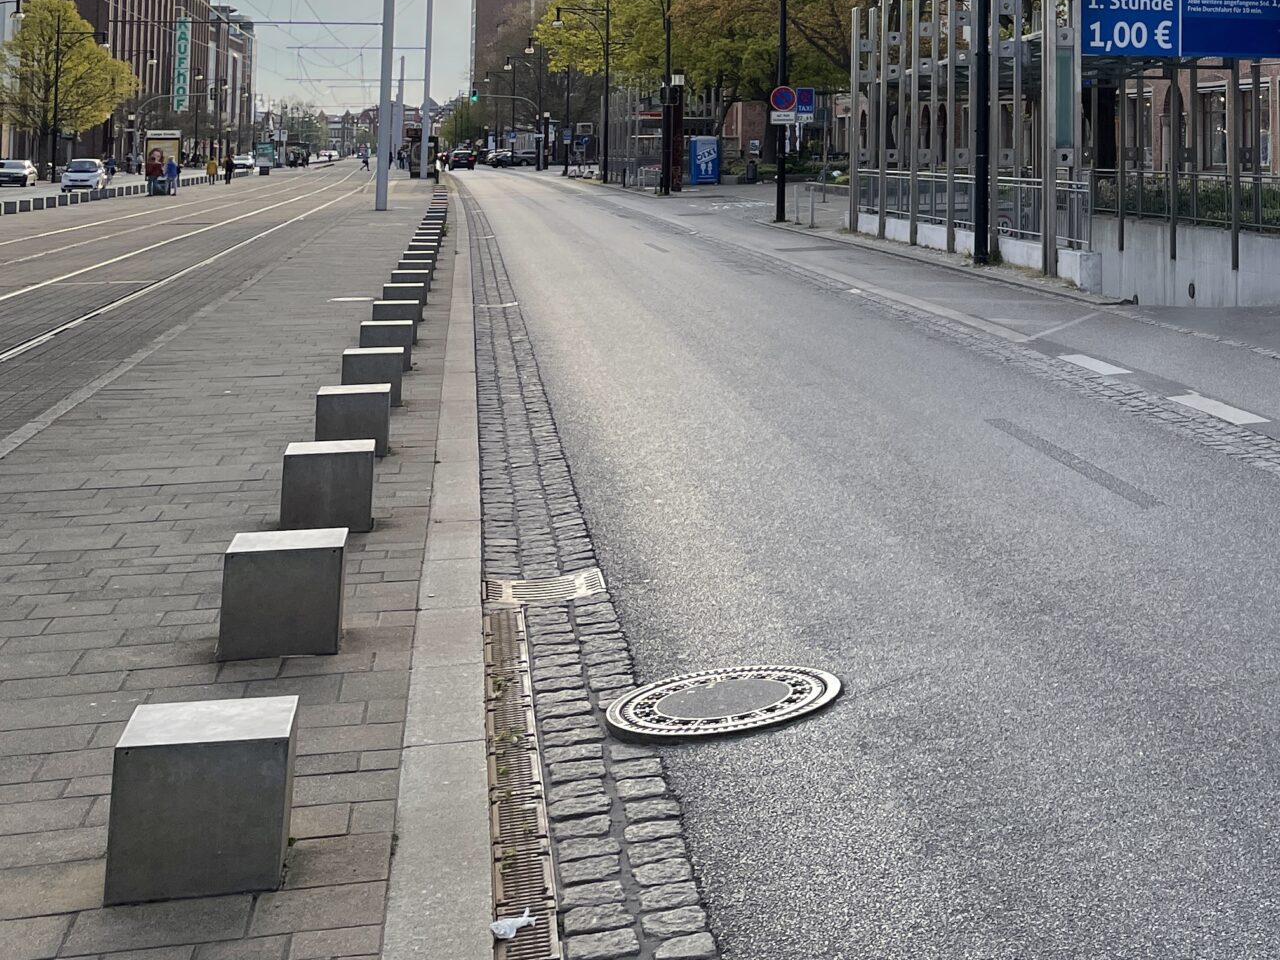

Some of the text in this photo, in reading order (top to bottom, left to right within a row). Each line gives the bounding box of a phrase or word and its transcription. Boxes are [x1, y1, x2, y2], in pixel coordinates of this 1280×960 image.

[1223, 0, 1259, 7] angefangene
[1089, 20, 1173, 52] 1,00 €
[798, 104, 813, 112] TAXI
[696, 147, 717, 161] DIXI
